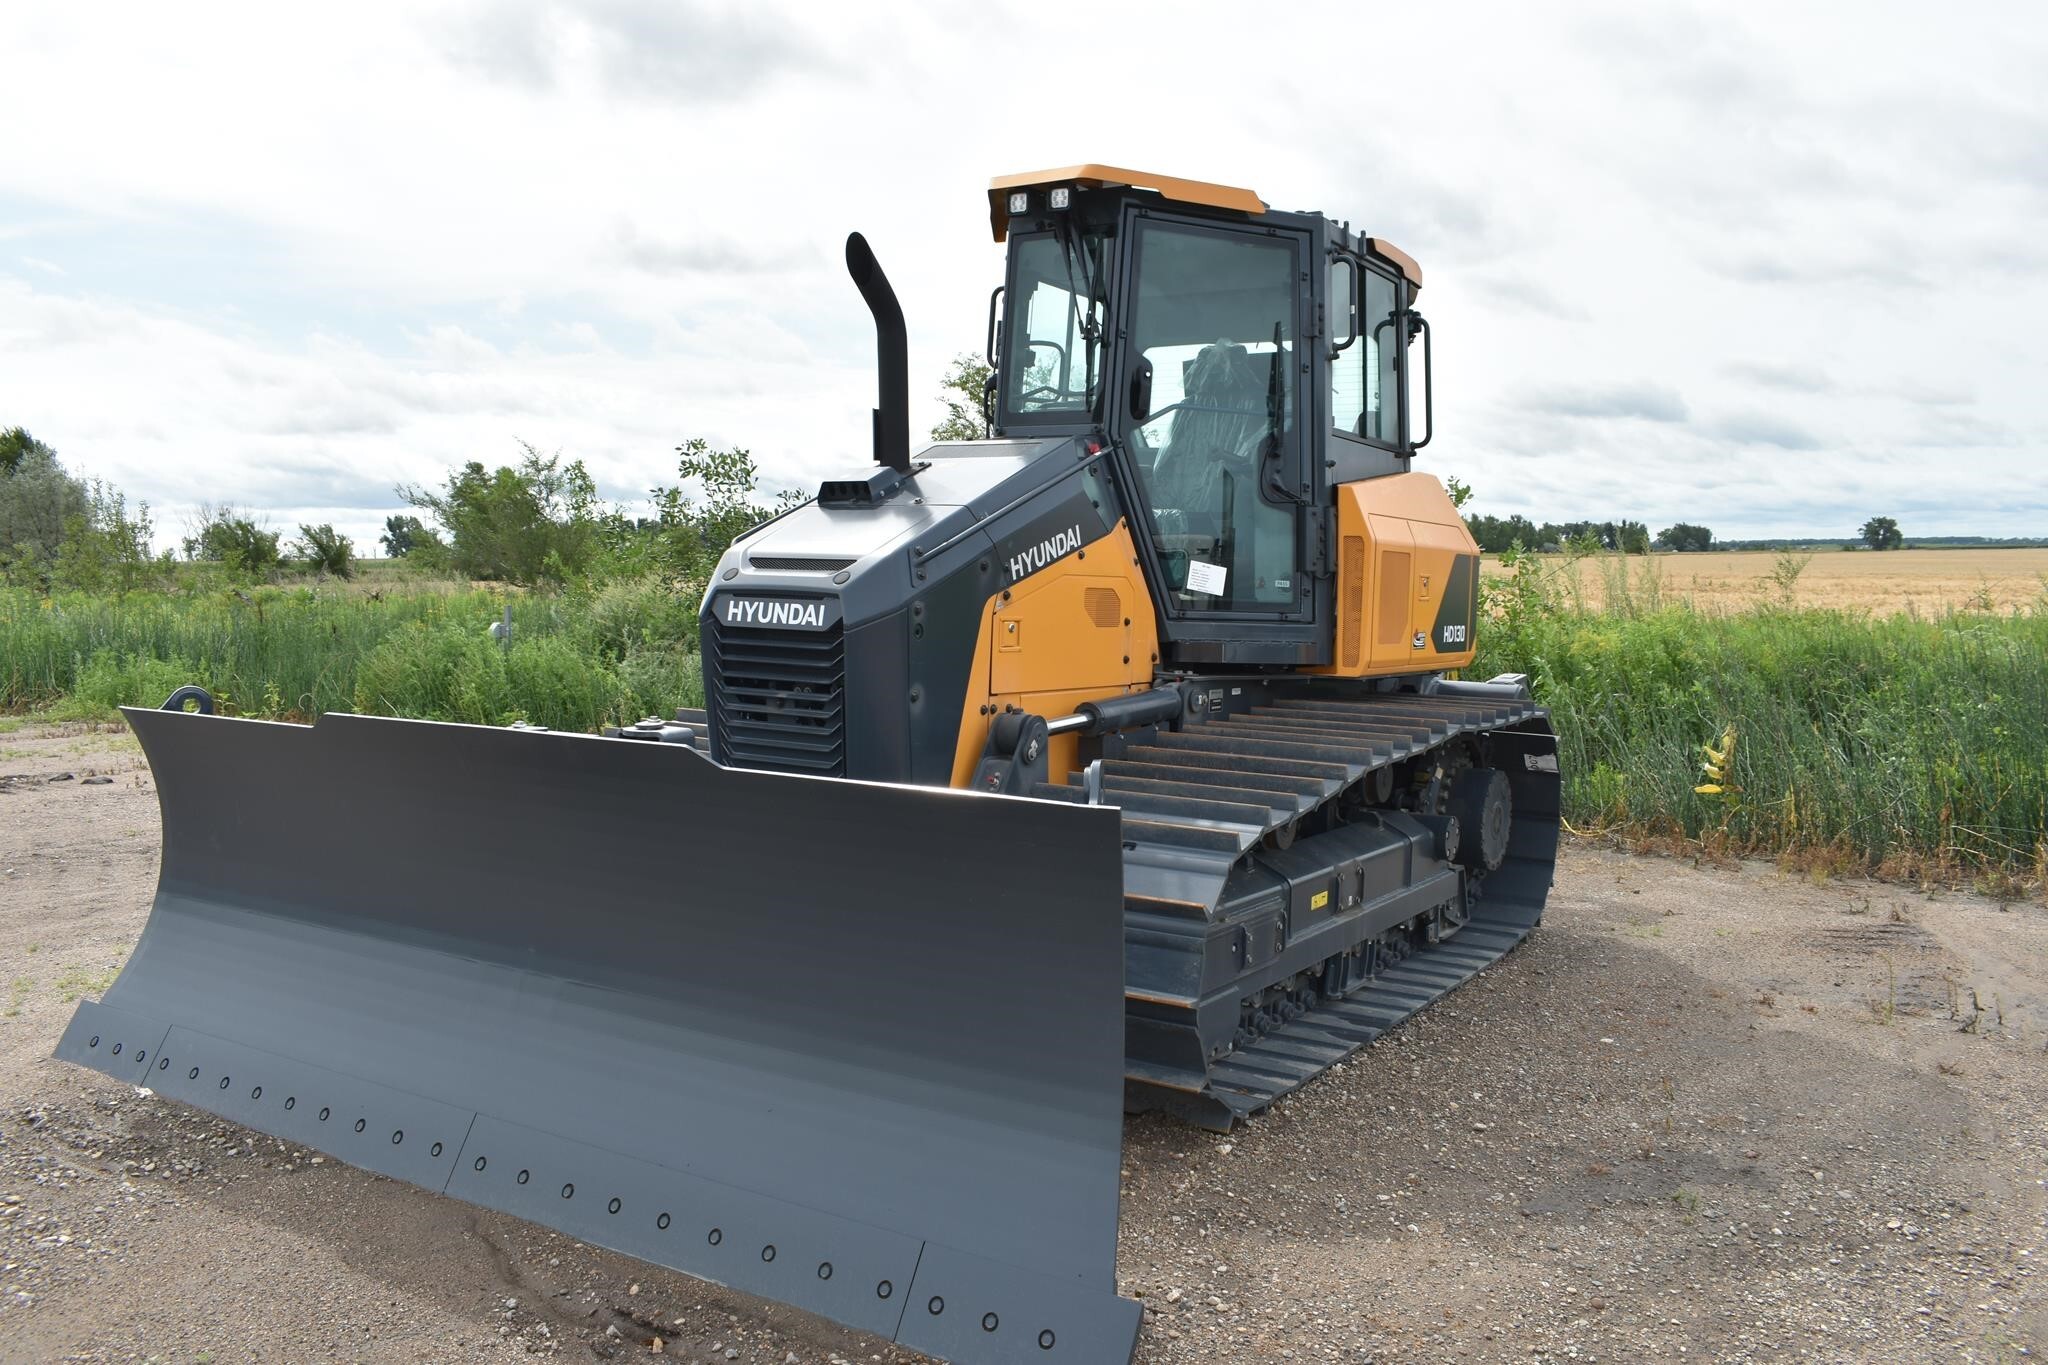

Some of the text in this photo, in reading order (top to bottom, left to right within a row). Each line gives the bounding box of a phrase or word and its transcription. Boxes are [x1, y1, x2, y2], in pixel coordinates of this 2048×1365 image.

[1010, 524, 1082, 581] HYUNDAI
[727, 600, 825, 626] HYUNDAI
[1443, 624, 1466, 643] HD130
